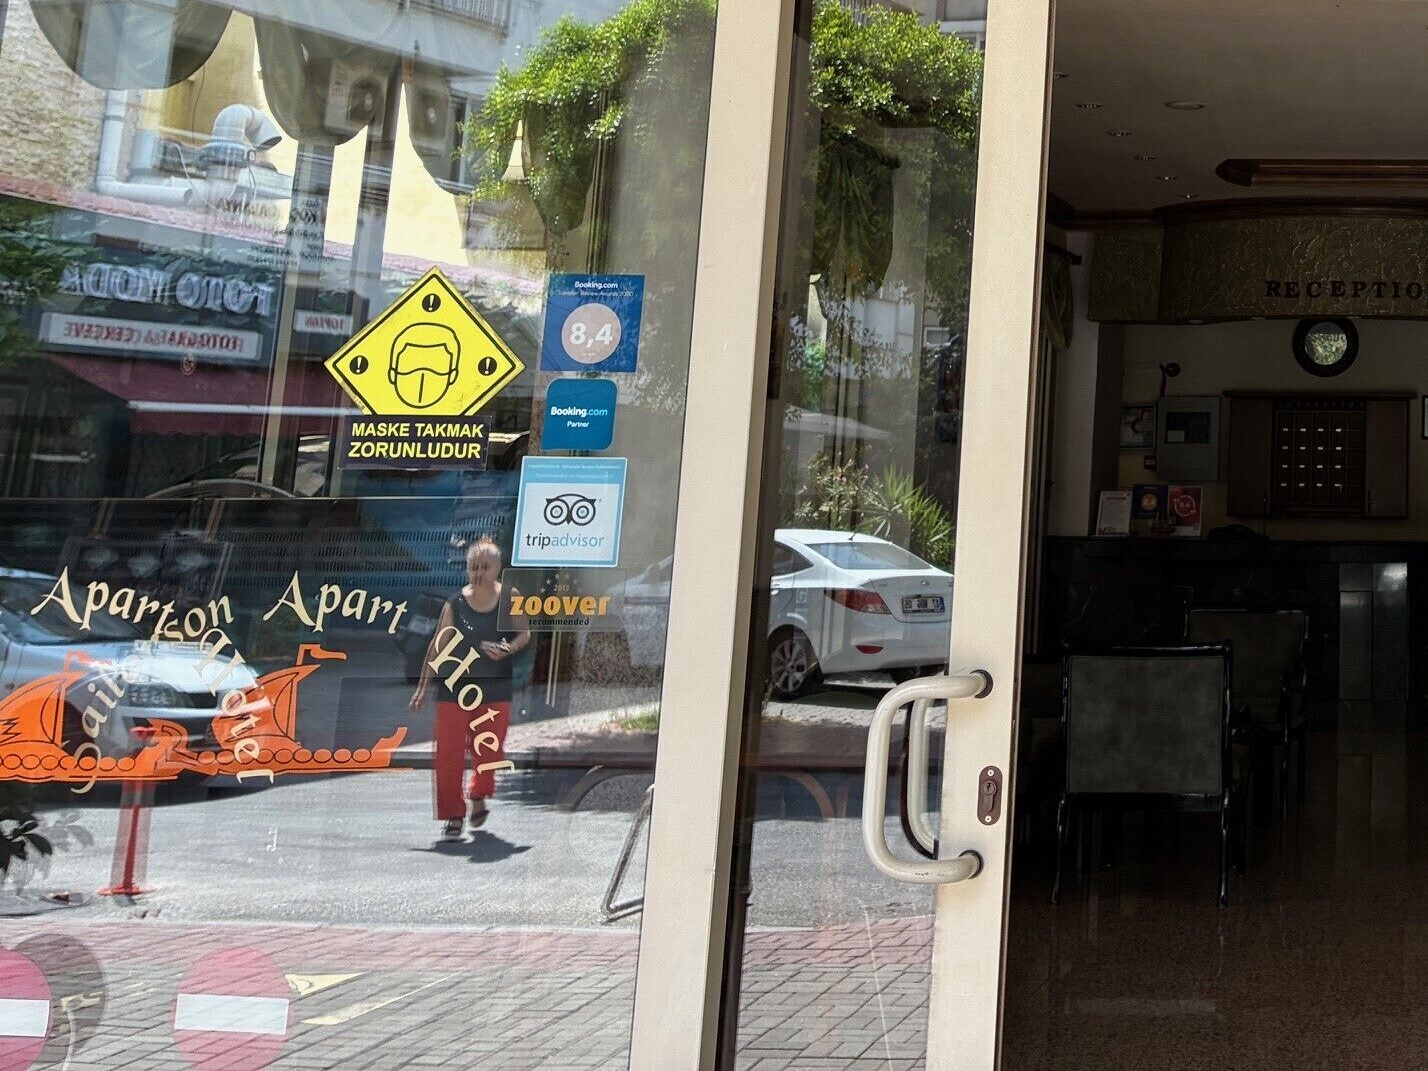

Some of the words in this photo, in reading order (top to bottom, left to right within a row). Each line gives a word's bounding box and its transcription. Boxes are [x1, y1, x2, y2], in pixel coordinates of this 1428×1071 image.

[574, 281, 618, 290] Booking.com
[569, 322, 614, 348] 8,4
[550, 406, 608, 418] Booking.com
[351, 422, 410, 437] MASKE
[414, 423, 484, 438] TAKMAK
[567, 420, 590, 428] Partner
[348, 441, 482, 459] ZORUNLUDUR
[525, 532, 605, 551] tripadvisor
[30, 565, 176, 635] Apart
[509, 595, 611, 617] zoover
[529, 617, 590, 626] recommended
[262, 570, 408, 635] Apart
[427, 625, 516, 776] Hotel
